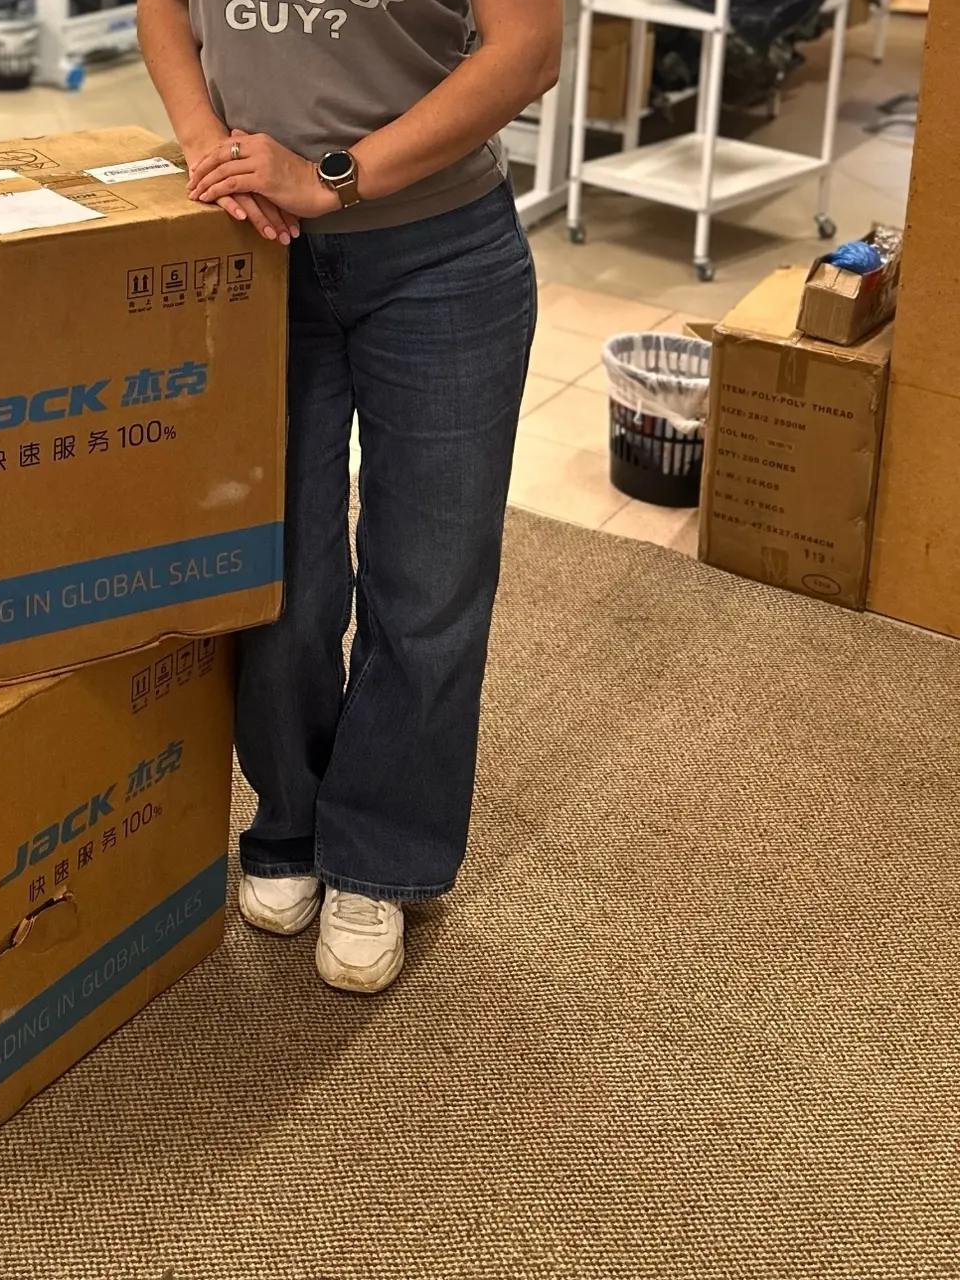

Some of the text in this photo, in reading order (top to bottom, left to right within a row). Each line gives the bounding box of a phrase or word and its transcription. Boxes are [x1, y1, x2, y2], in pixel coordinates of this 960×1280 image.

[121, 360, 209, 407] 杰克
[751, 390, 807, 409] POLY-POLY
[812, 403, 854, 420] THREAD
[117, 420, 177, 449] 100%
[719, 426, 738, 438] COL
[761, 458, 796, 473] CONES
[26, 590, 51, 618] IN
[61, 567, 162, 609] GLOBAL
[169, 549, 243, 587] SALES
[125, 739, 184, 804] 杰克
[122, 802, 163, 838] 100%
[56, 989, 76, 1018] IN
[82, 934, 149, 998] GLOBAL
[154, 889, 203, 944] SALES
